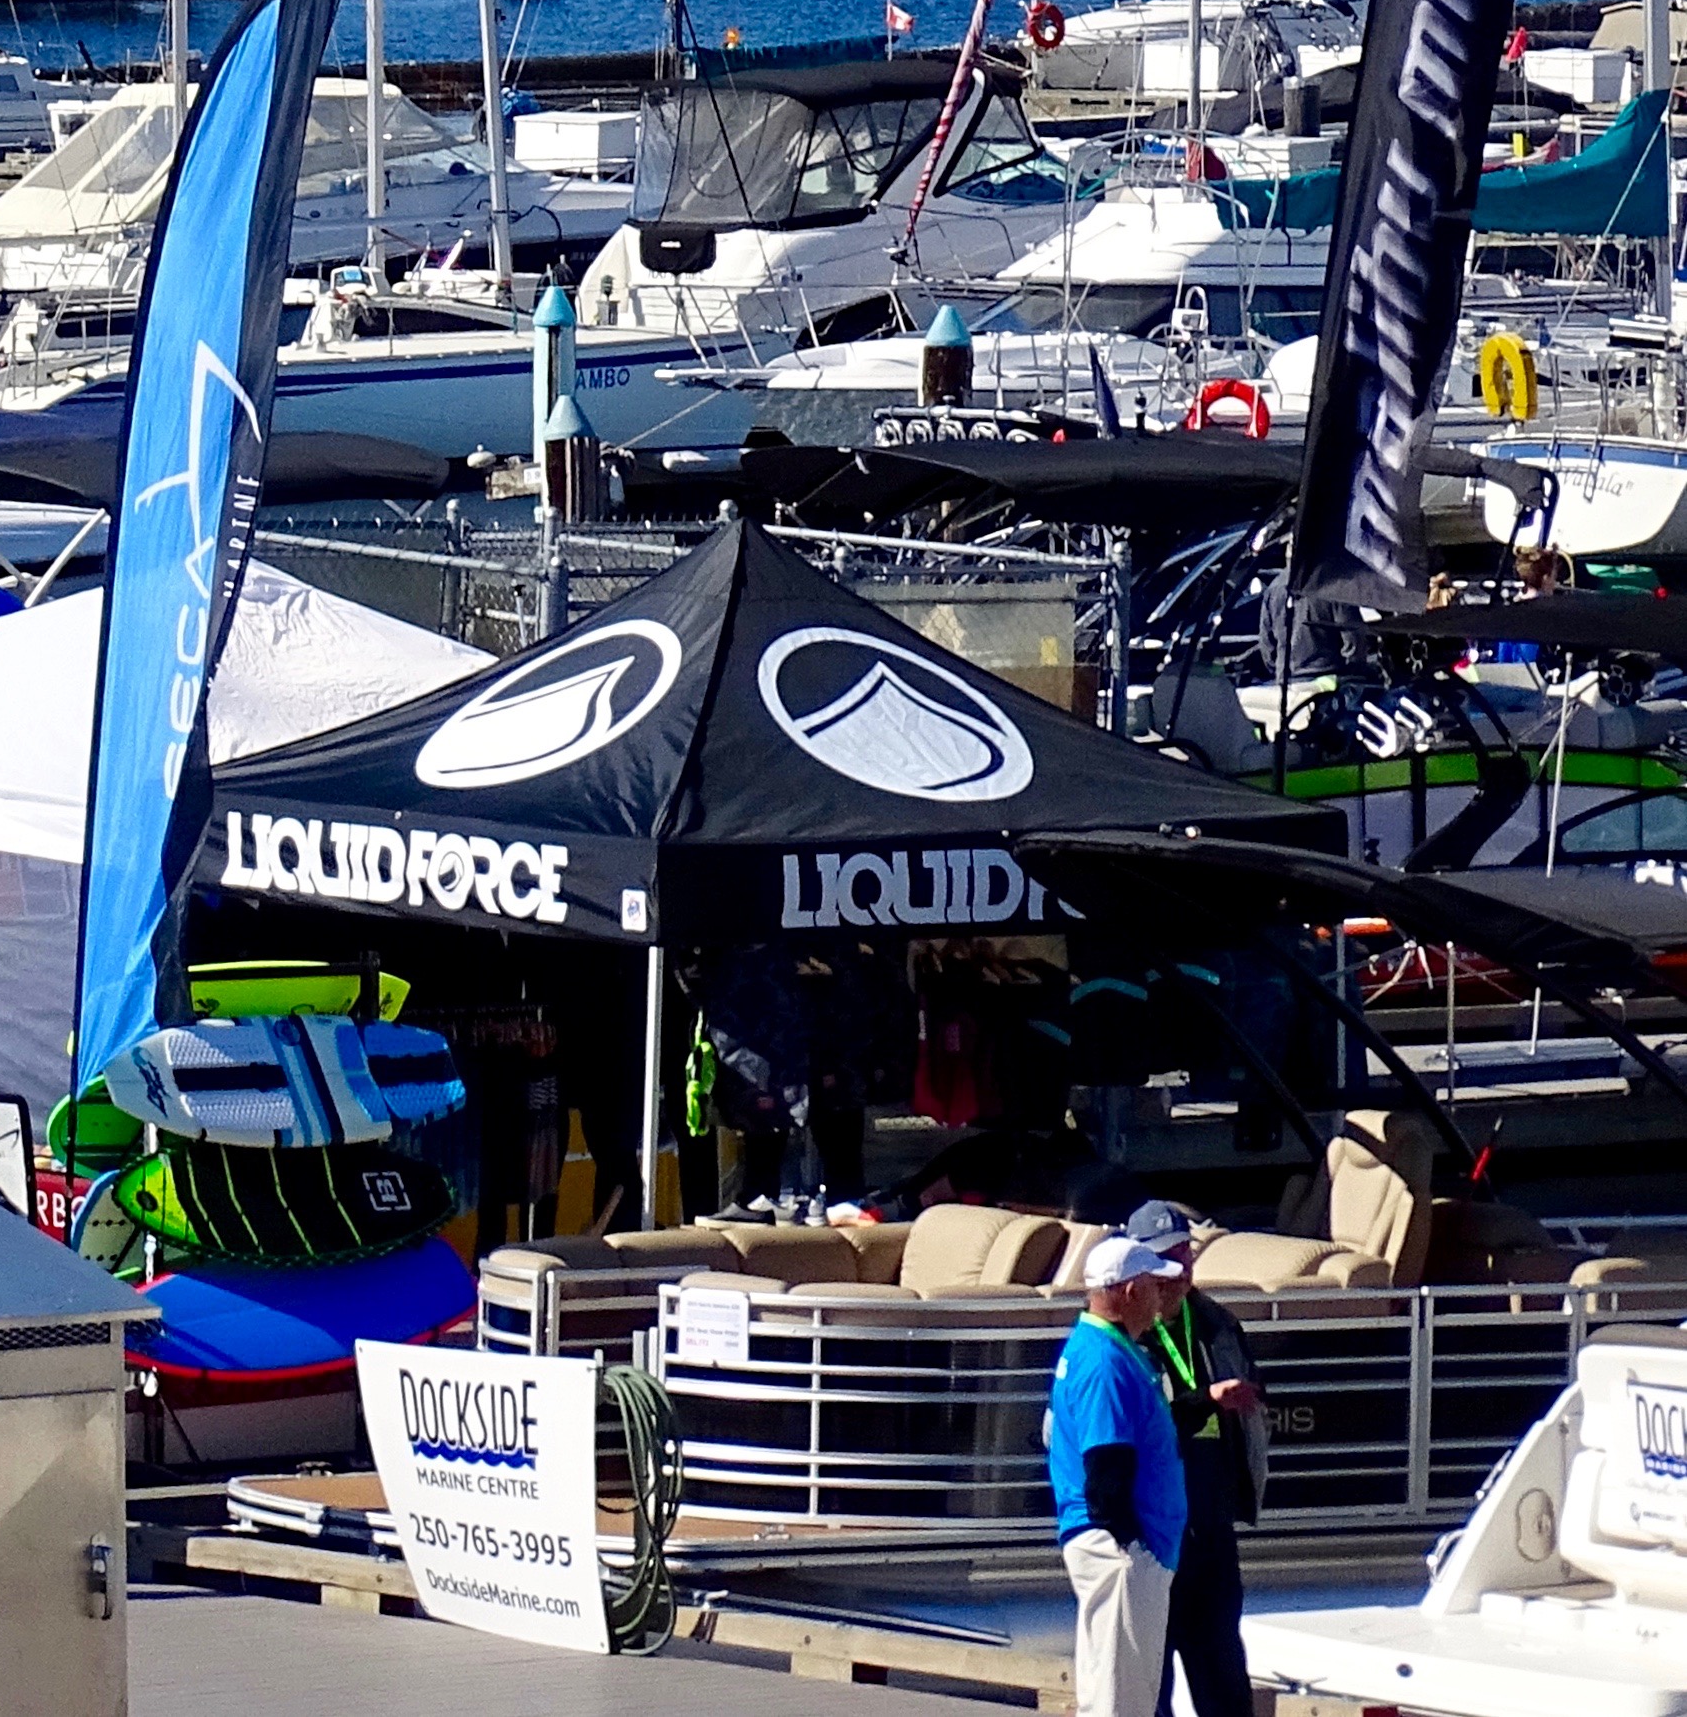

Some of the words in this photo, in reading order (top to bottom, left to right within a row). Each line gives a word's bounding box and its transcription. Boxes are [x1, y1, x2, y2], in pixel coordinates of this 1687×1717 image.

[399, 1368, 539, 1456] DOCKSIDE
[416, 1466, 474, 1492] MARINE
[477, 1475, 540, 1500] CENTRE
[409, 1513, 573, 1567] 250-765-3995
[425, 1568, 581, 1618] DocksideMarine.com
